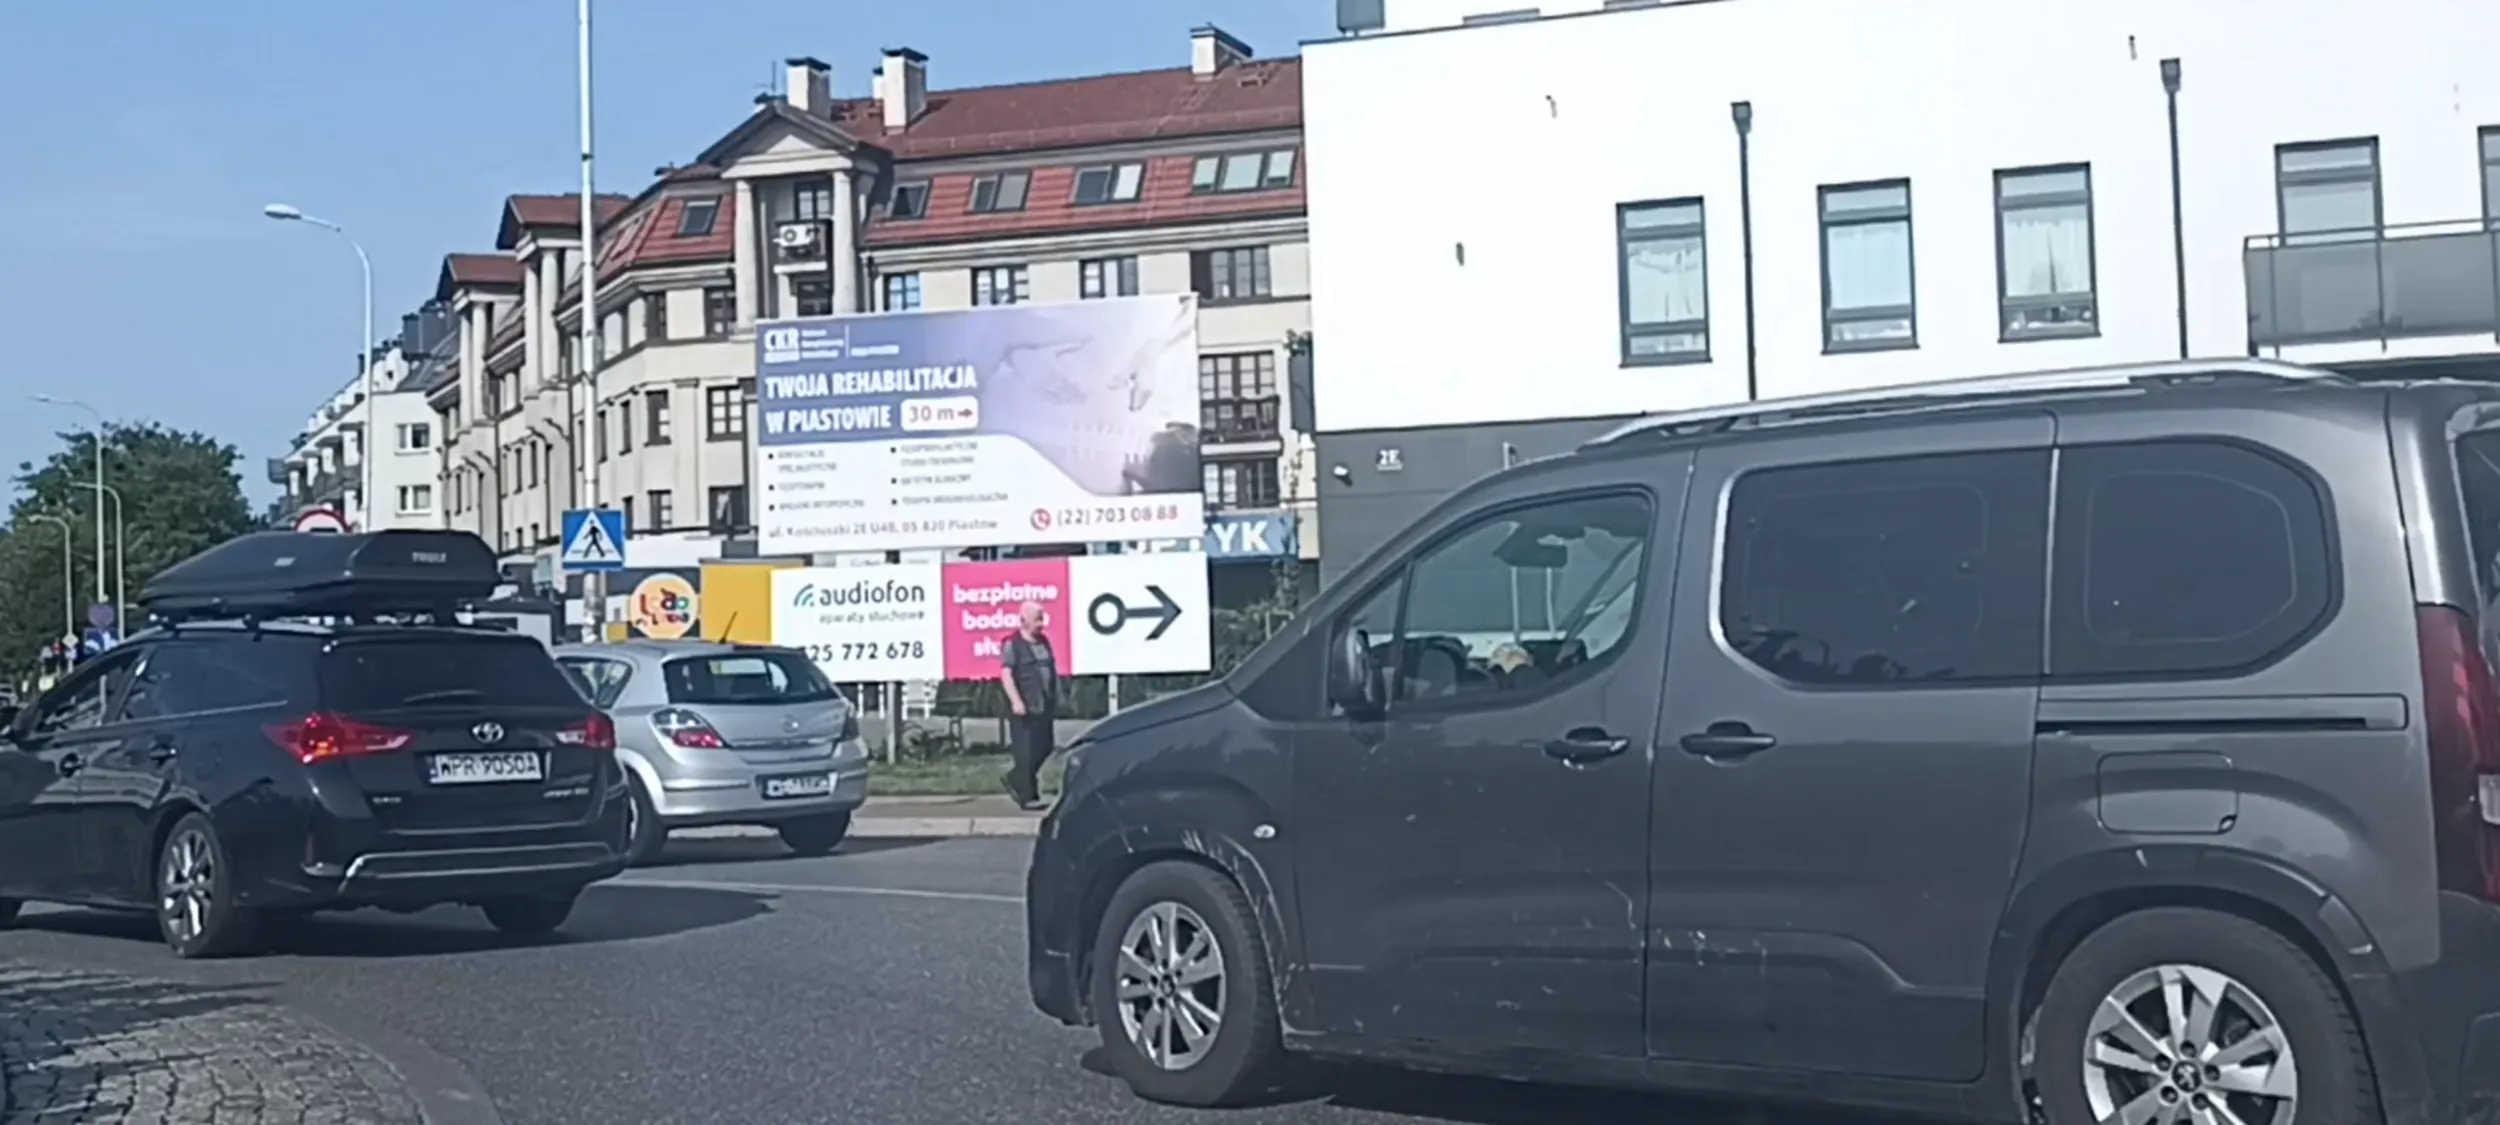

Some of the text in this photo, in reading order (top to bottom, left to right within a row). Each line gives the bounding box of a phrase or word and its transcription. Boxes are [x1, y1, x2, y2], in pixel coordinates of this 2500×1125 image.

[765, 365, 978, 398] TWOJA REHABILITACJA
[766, 405, 892, 434] W PIASTOWIE
[909, 406, 955, 423] 30 m
[1096, 506, 1126, 523] 703
[1131, 505, 1152, 521] 08
[1156, 504, 1179, 520] 88
[819, 580, 925, 606] audiofon
[952, 581, 1060, 606] bezpłatne
[801, 641, 925, 662] 25 772 678
